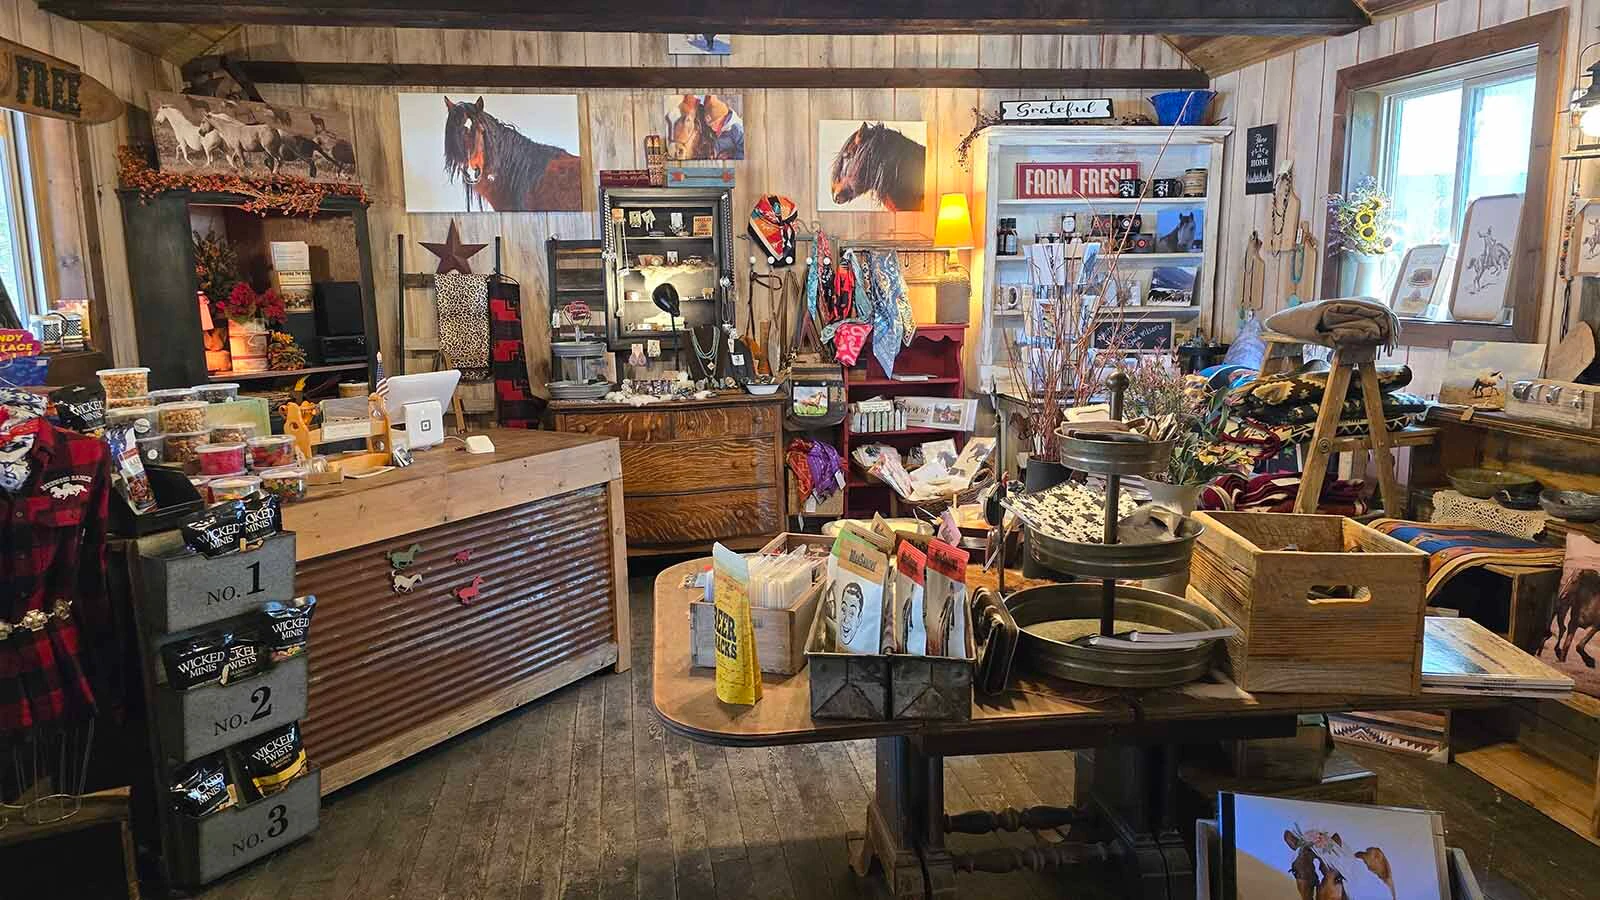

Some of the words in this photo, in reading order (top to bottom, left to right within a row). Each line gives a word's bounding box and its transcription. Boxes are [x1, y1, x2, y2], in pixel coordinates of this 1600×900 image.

[16, 55, 81, 116] FREE
[1017, 101, 1096, 117] Grateful
[1251, 158, 1269, 168] HOME
[1025, 168, 1073, 195] FARM
[197, 523, 240, 544] WICKED
[210, 534, 234, 549] MINIS
[208, 586, 240, 605] NO.
[246, 561, 265, 595] 1
[272, 617, 310, 633] WICKED
[281, 628, 304, 640] MINIS
[178, 651, 225, 673] WICKED
[190, 663, 217, 678] MINIS
[228, 655, 257, 670] WISTS
[214, 714, 248, 736] NO.
[250, 686, 272, 722] 2
[252, 732, 295, 761] WICKED
[262, 743, 294, 765] TWISTS
[231, 833, 264, 856] NO.
[267, 804, 289, 838] 3
